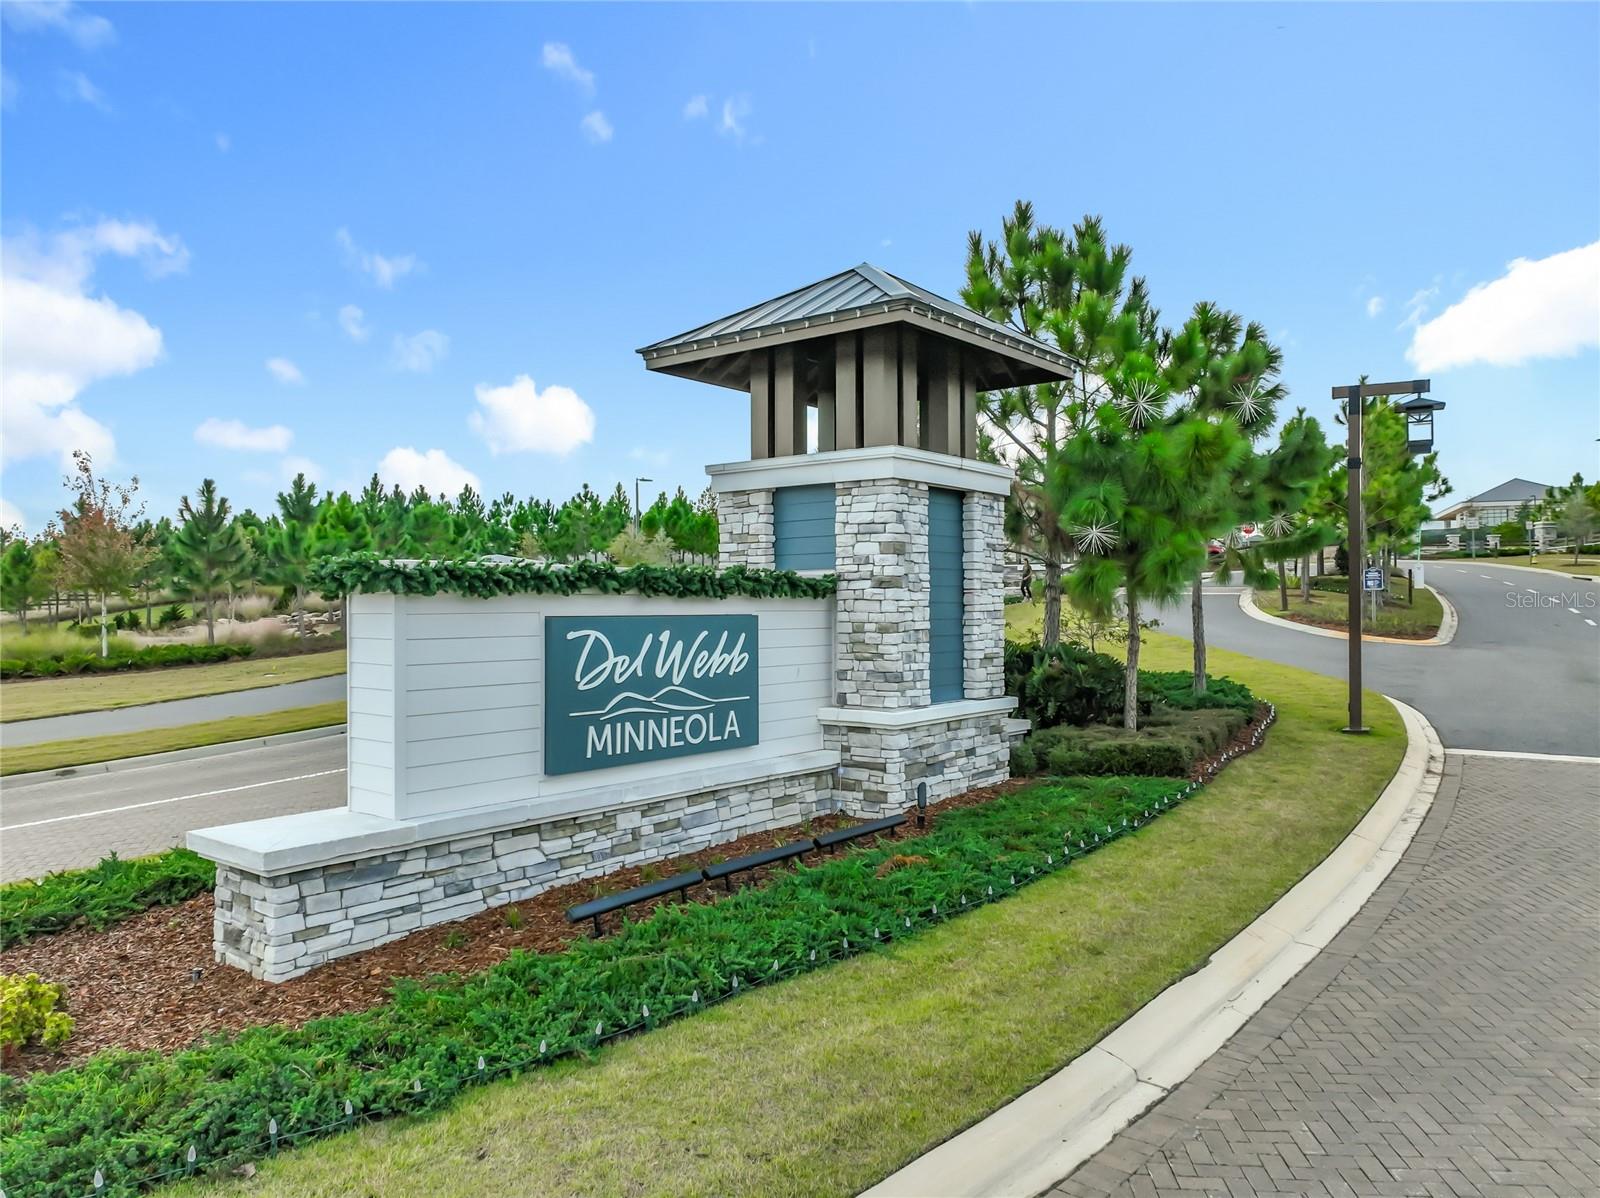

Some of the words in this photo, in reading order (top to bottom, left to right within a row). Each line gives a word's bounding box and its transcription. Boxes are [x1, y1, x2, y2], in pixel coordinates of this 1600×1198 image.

[566, 630, 653, 691] Del
[655, 630, 749, 685] Webb
[586, 710, 741, 758] MINNEOLA
